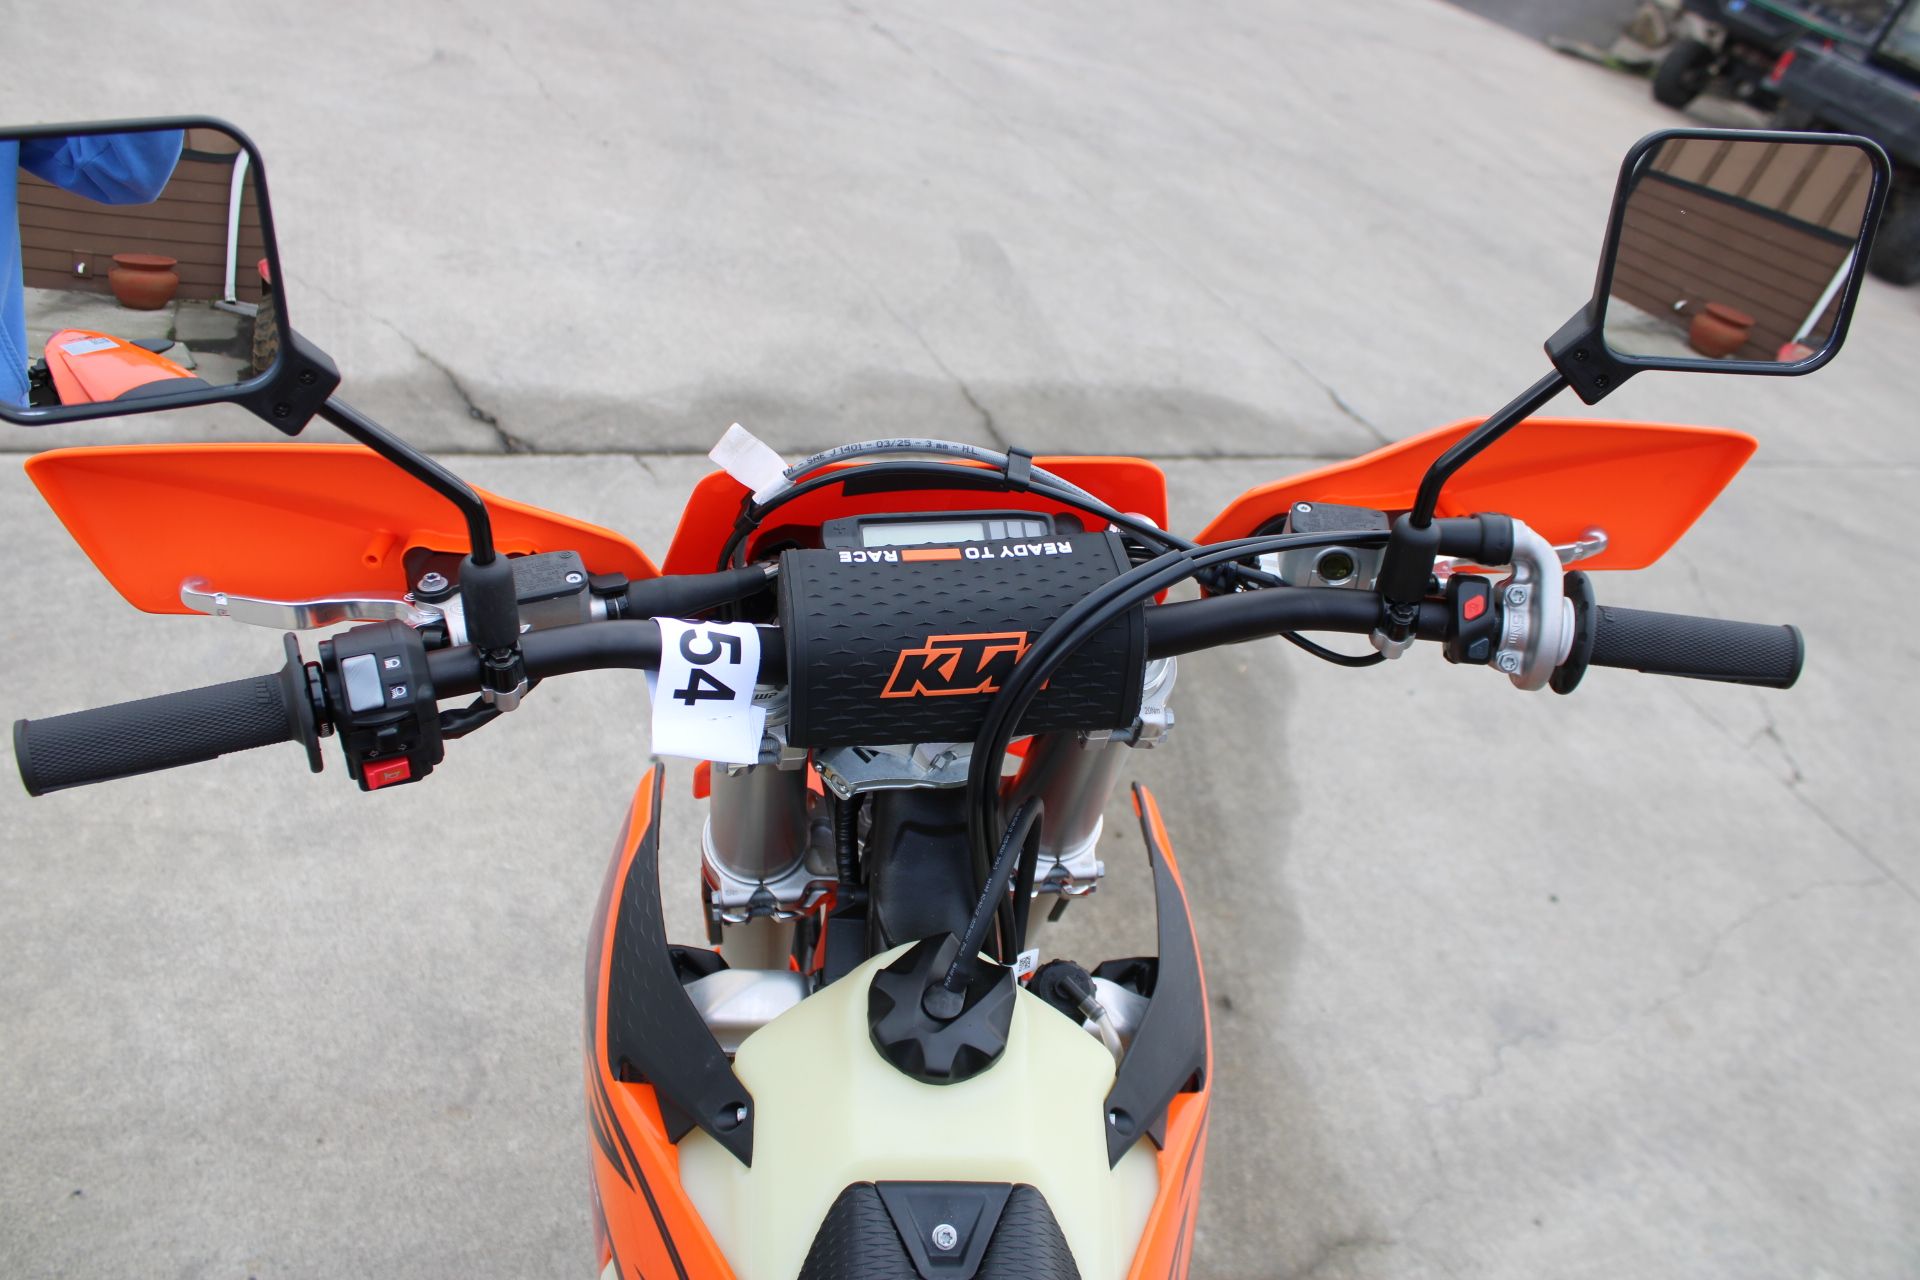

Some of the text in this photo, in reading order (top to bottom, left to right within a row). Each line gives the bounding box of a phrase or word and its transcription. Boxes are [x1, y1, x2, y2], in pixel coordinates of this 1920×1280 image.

[876, 439, 911, 448] 03/25
[926, 440, 932, 448] 3
[839, 541, 1073, 563] READY TO RACE
[673, 620, 742, 706] 54
